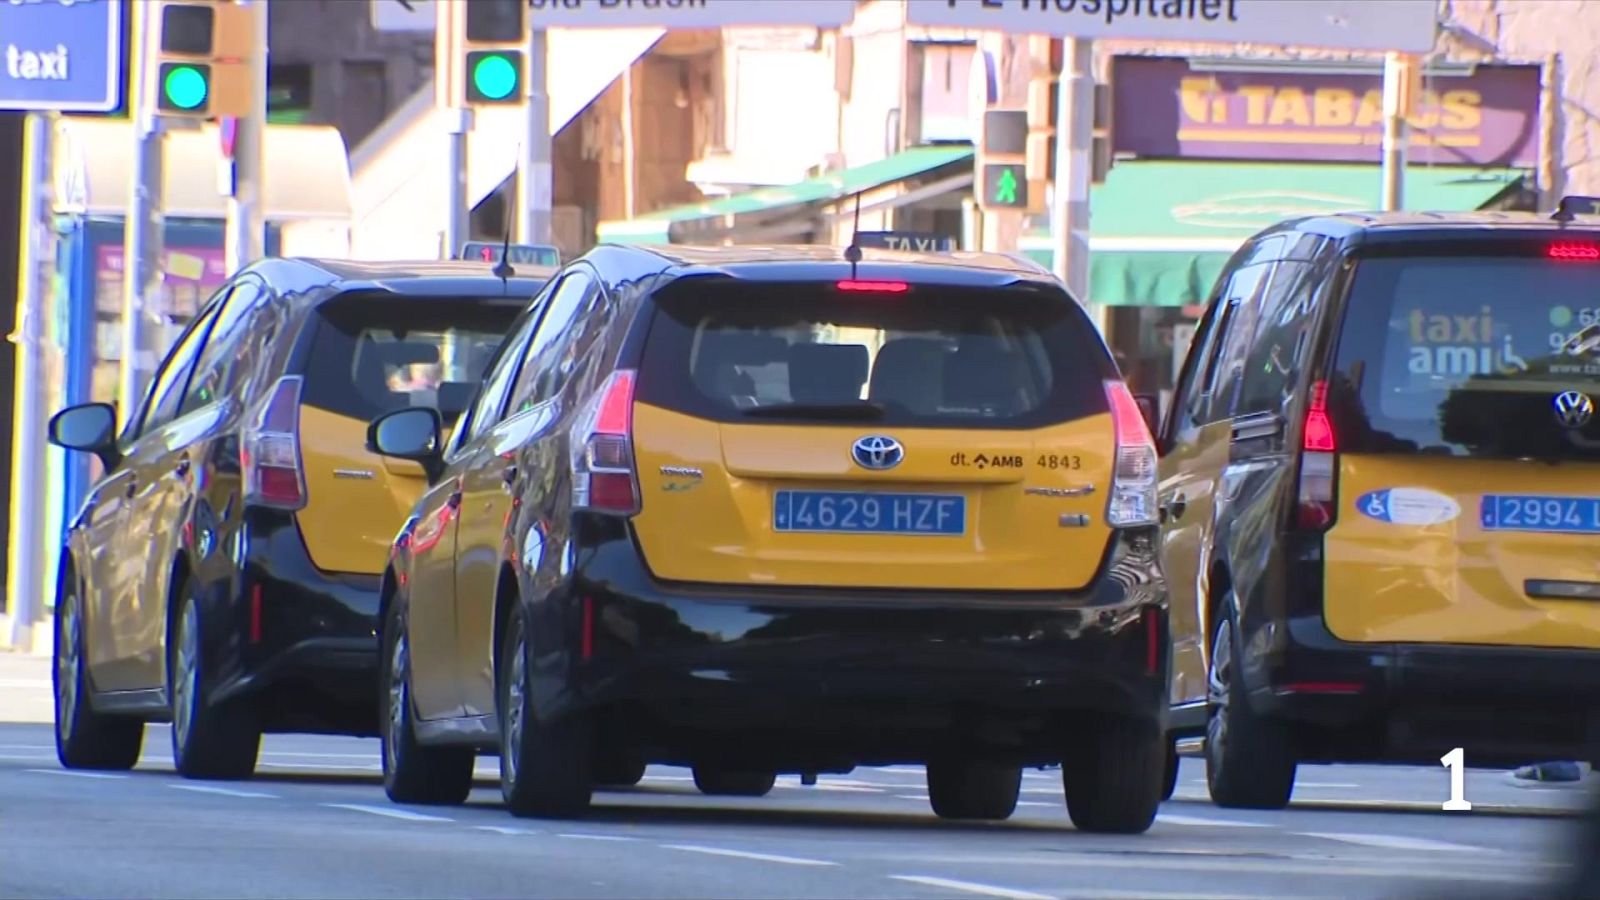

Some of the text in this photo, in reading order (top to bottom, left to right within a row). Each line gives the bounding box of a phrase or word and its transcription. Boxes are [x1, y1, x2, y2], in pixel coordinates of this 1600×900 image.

[7, 43, 68, 80] taxi
[1409, 305, 1493, 344] taxi
[950, 452, 1082, 470] dt. AMB 4843
[796, 496, 956, 530] 4629 HZF
[1503, 499, 1583, 526] 2994
